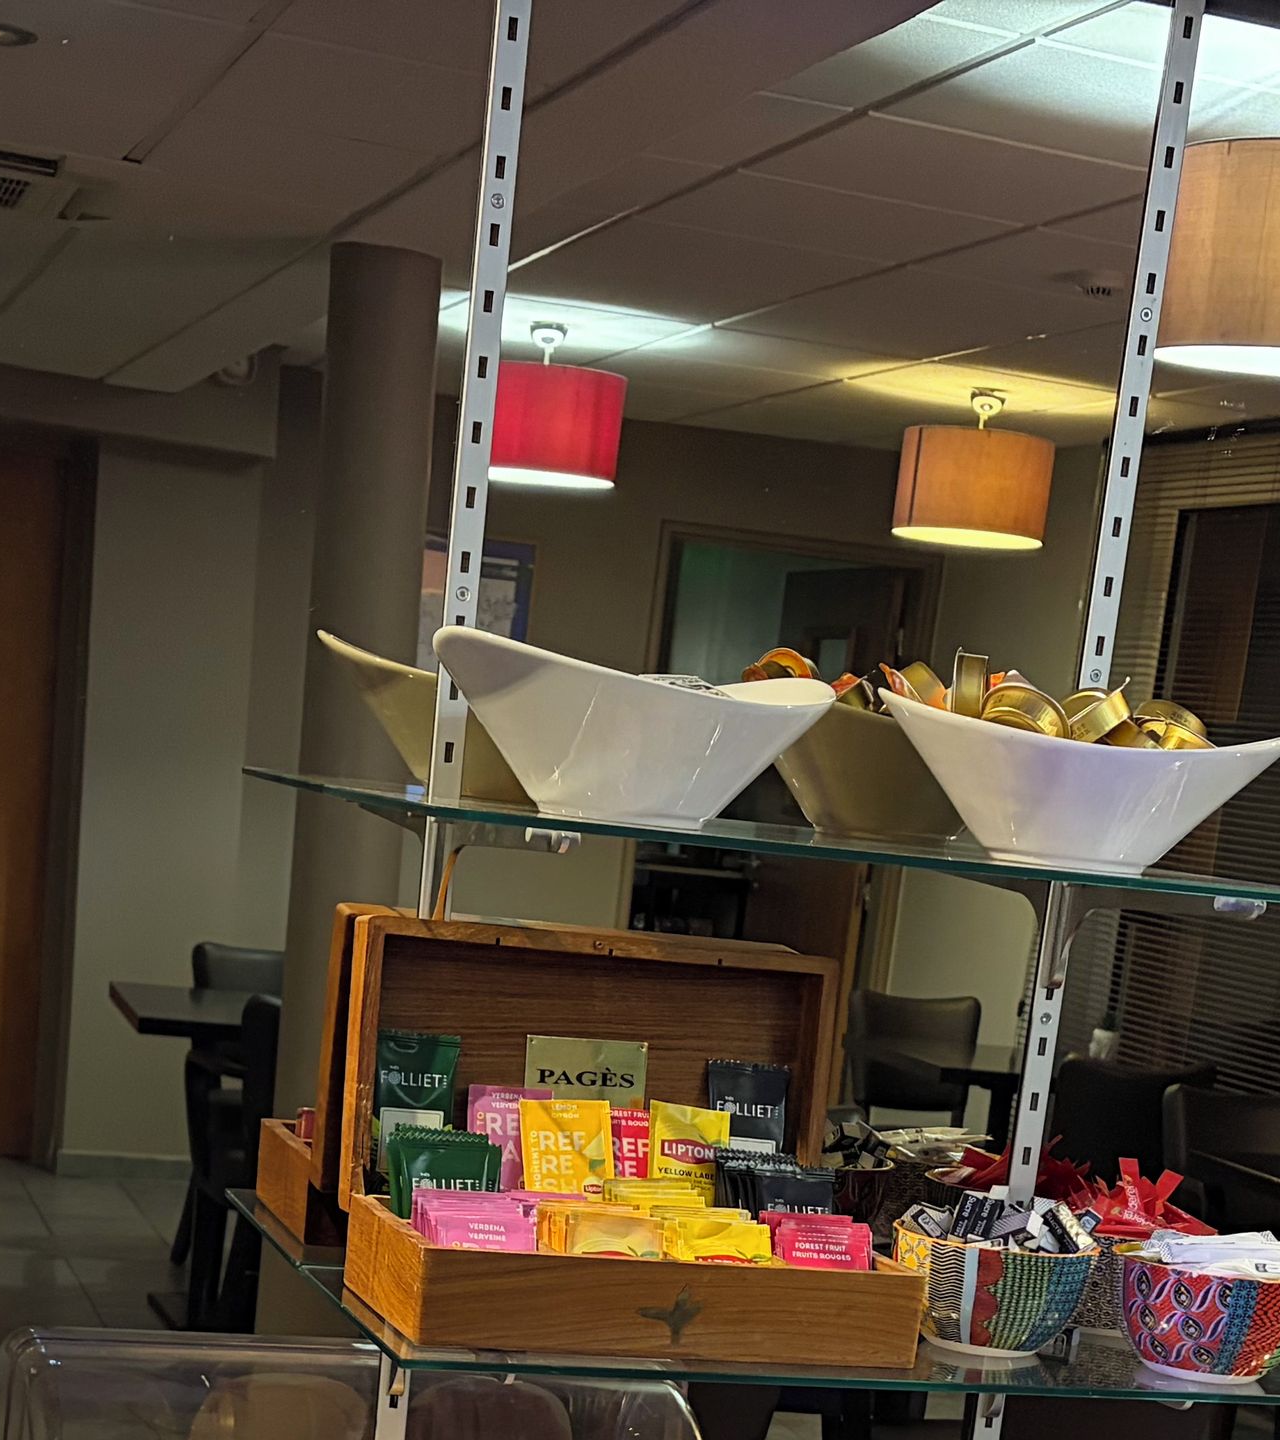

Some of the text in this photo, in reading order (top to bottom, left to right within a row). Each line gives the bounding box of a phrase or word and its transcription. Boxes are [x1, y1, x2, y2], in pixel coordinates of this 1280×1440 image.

[536, 1067, 635, 1089] PAGÈS
[663, 1141, 714, 1160] LIPTON
[658, 1166, 693, 1177] YELLOW
